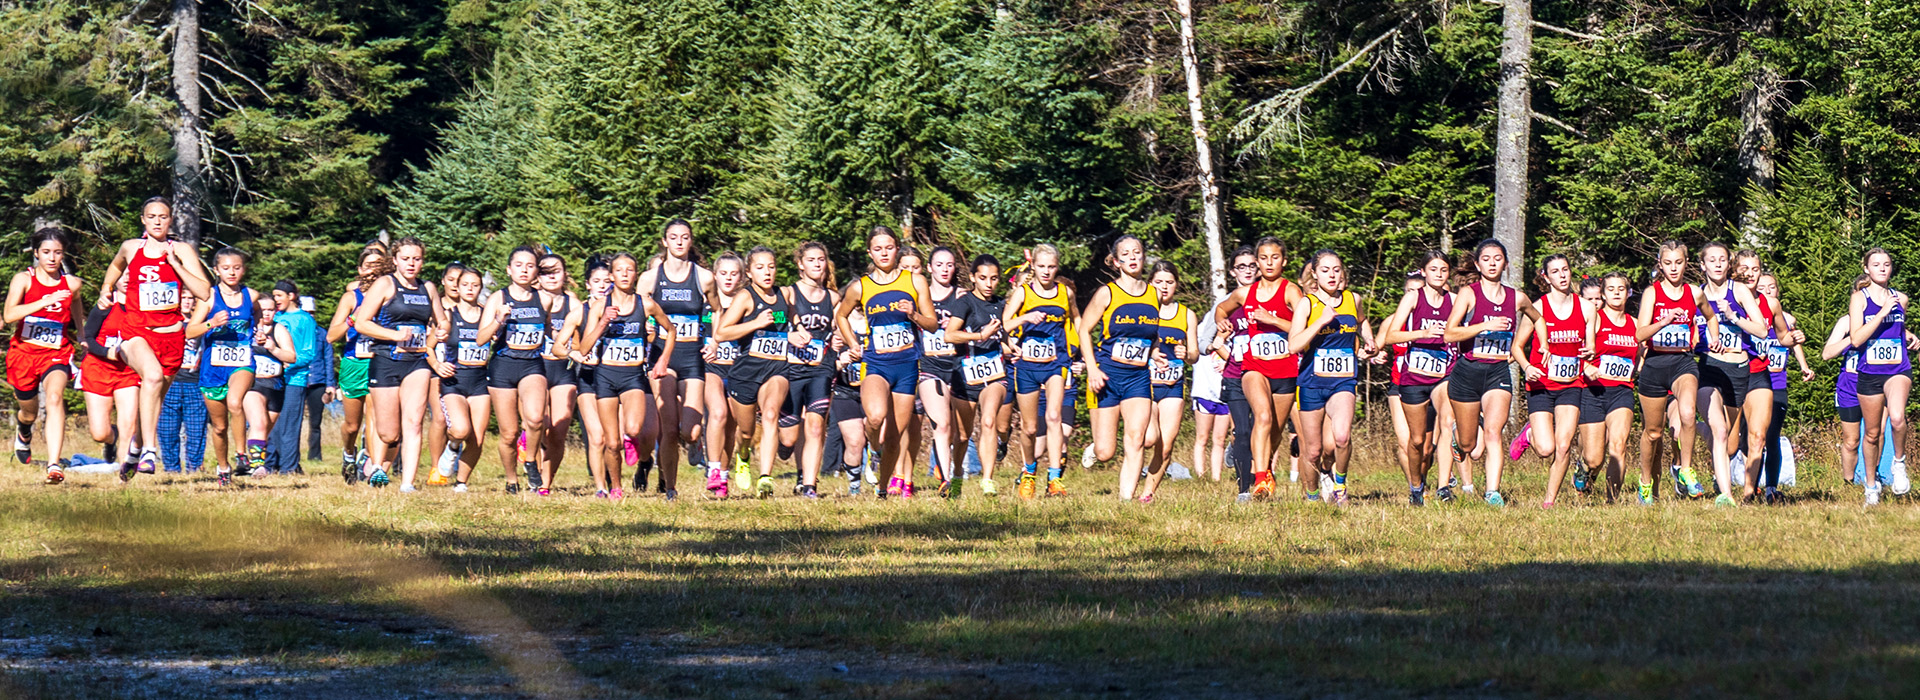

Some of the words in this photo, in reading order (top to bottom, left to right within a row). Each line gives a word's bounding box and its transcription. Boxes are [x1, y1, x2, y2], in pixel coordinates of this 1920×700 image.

[146, 289, 174, 305] 1842
[661, 288, 692, 301] PERU
[868, 304, 887, 314] Lake
[1115, 315, 1136, 324] Lake
[29, 324, 58, 345] 1835
[512, 331, 540, 345] 1743
[880, 330, 910, 348] 1678
[1550, 330, 1579, 339] SARANAC
[1659, 332, 1687, 347] 1811
[217, 347, 246, 361] 1862
[464, 348, 488, 361] 1740
[609, 347, 639, 361] 1754
[757, 339, 784, 355] 1694
[1028, 343, 1054, 358] 1676
[1120, 343, 1146, 360] 1674
[1256, 339, 1286, 356] 1810
[1479, 339, 1507, 355] 1714
[1872, 347, 1898, 360] 1887
[970, 360, 998, 379] 1651
[1321, 357, 1349, 372] 1681
[1415, 356, 1443, 373] 1716
[1605, 362, 1631, 377] 1806
